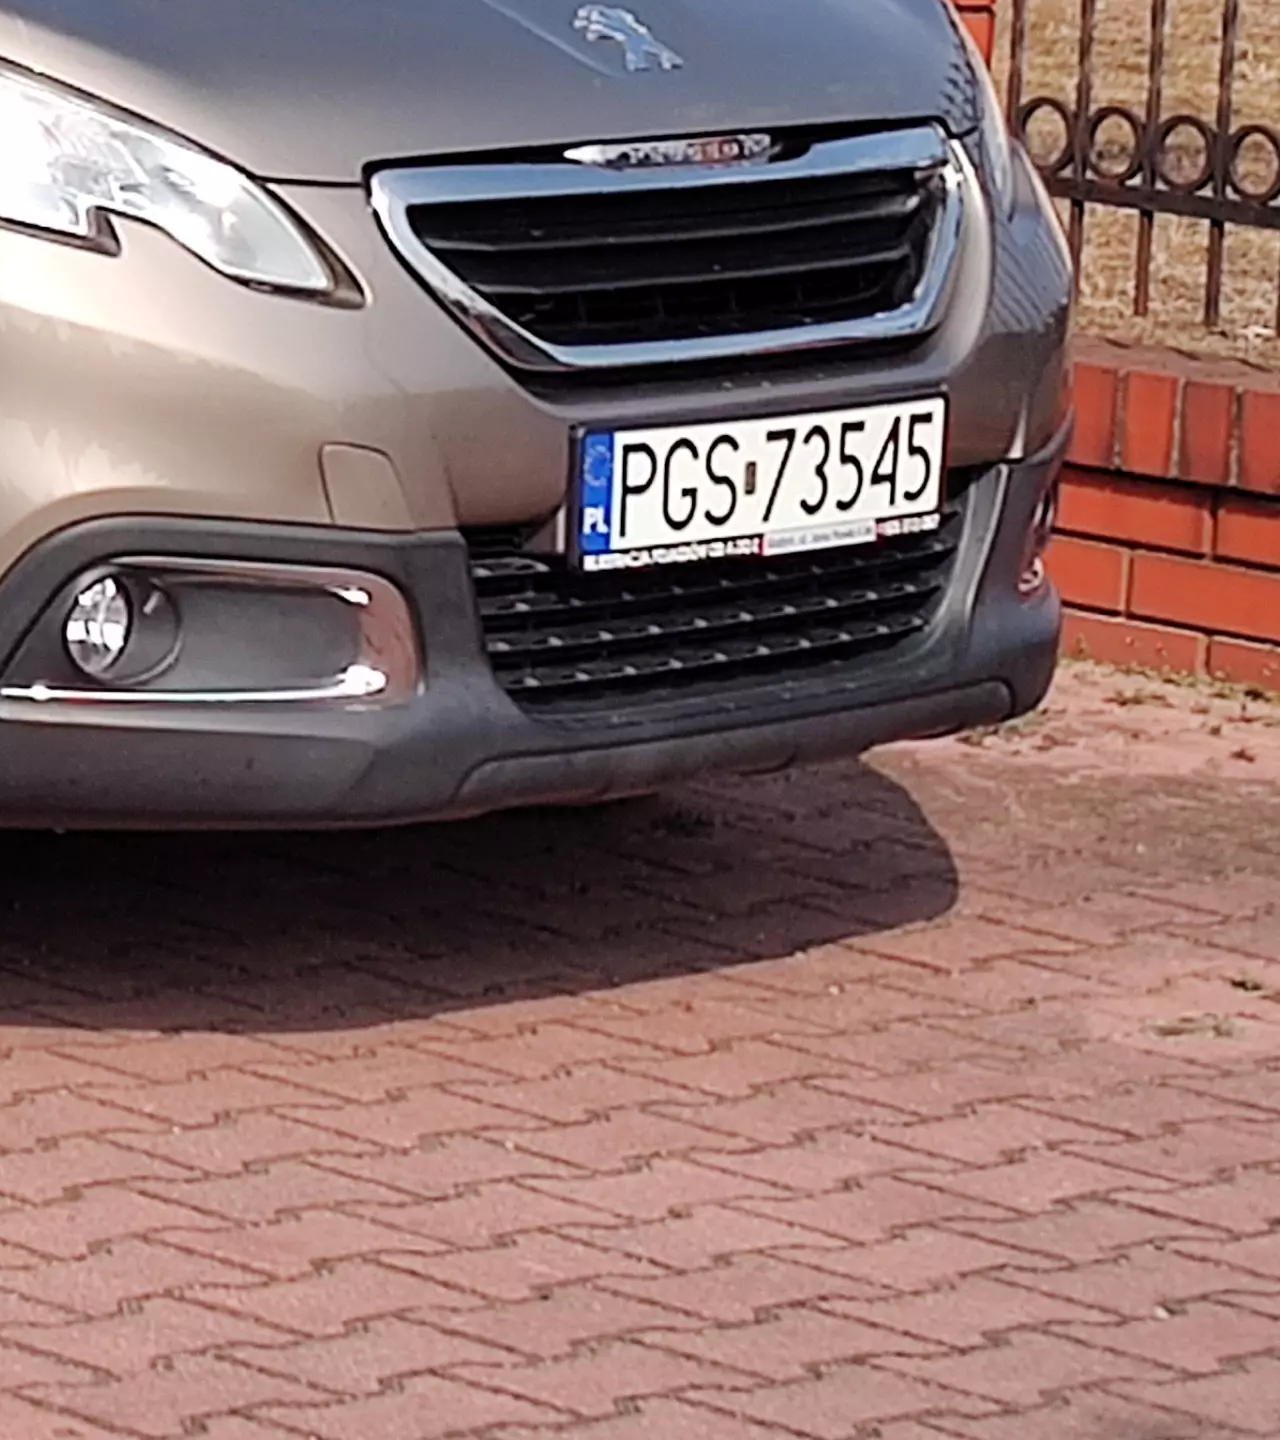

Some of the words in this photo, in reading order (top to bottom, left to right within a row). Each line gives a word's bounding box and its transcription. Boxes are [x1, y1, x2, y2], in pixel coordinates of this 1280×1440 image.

[620, 434, 739, 538] PGS
[763, 412, 933, 522] 73545
[582, 505, 609, 535] PL
